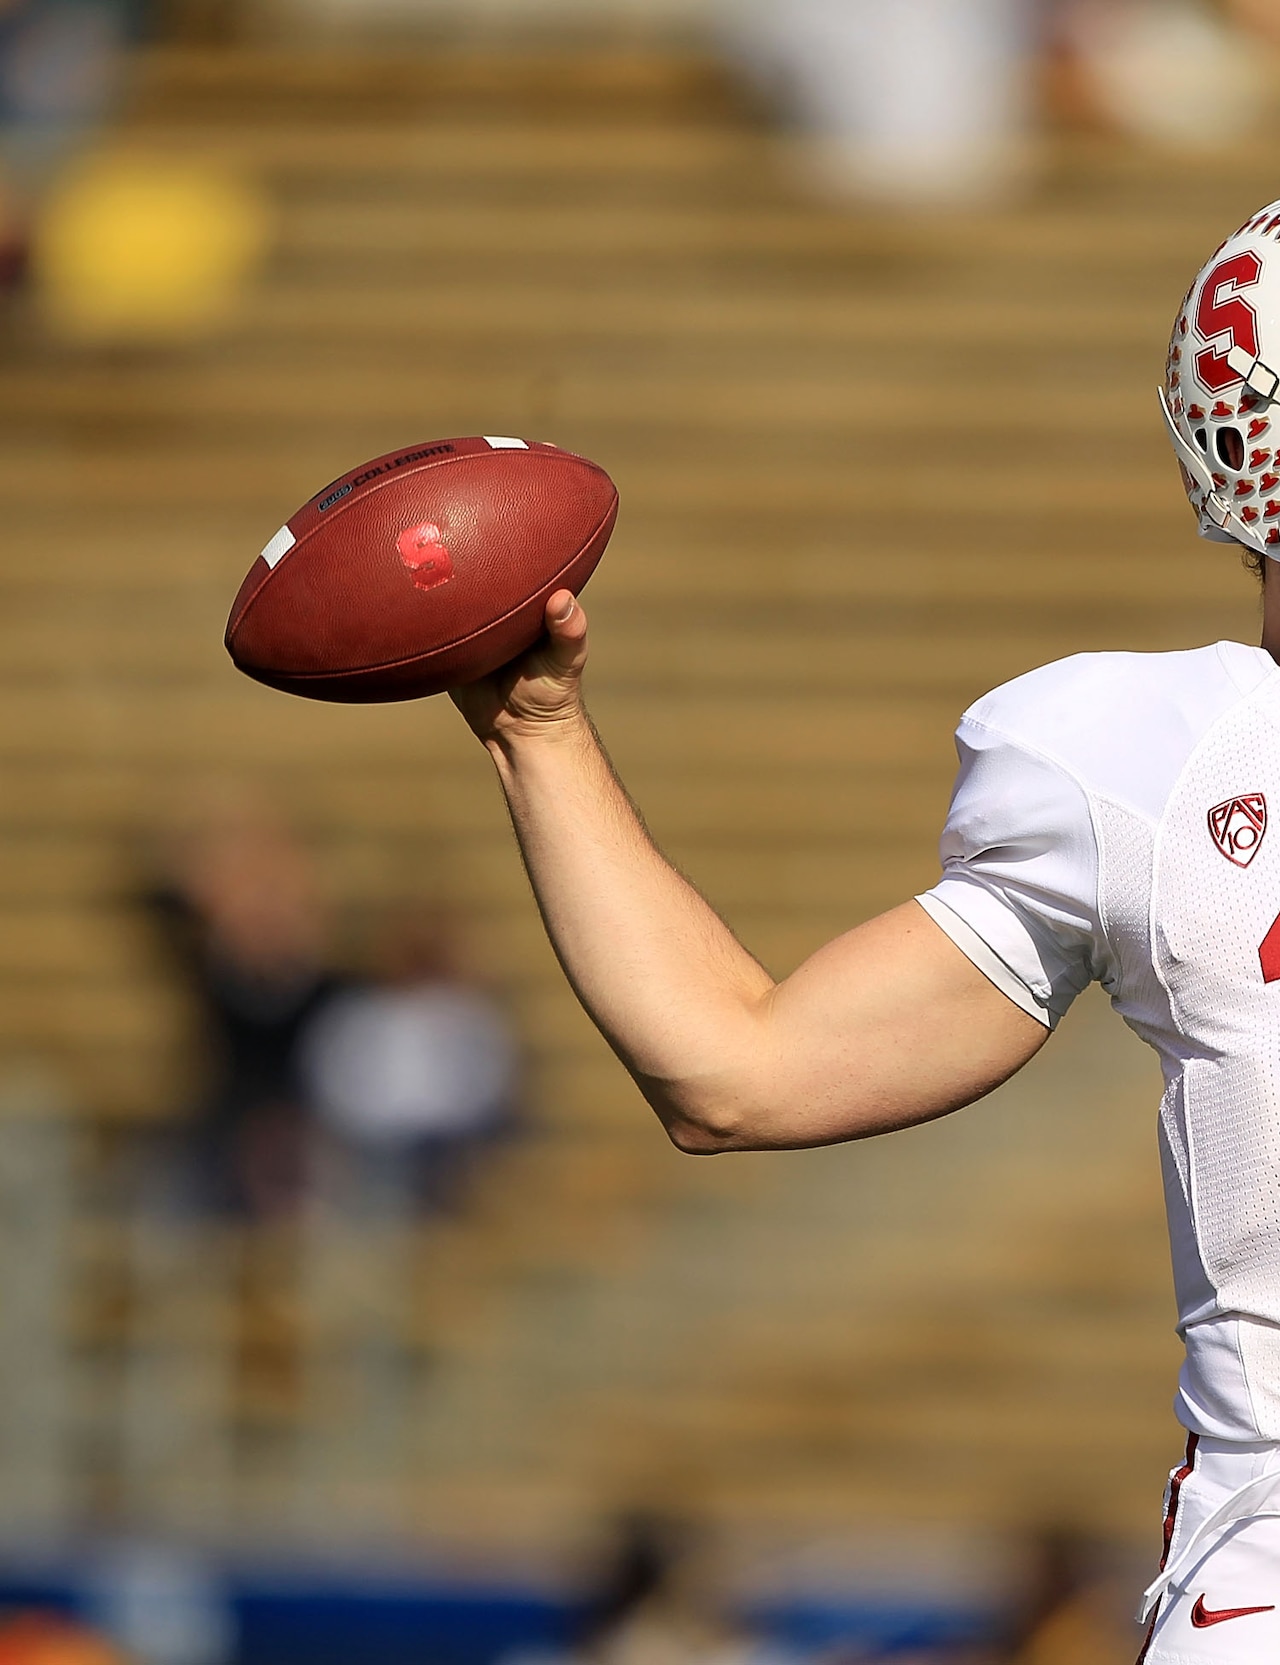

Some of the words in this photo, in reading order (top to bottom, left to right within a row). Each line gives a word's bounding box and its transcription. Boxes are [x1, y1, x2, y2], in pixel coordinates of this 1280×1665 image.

[1195, 250, 1262, 394] S
[353, 443, 456, 487] COLLEGIATE
[396, 522, 455, 591] S
[1211, 797, 1263, 845] PAC
[1227, 826, 1258, 855] 10
